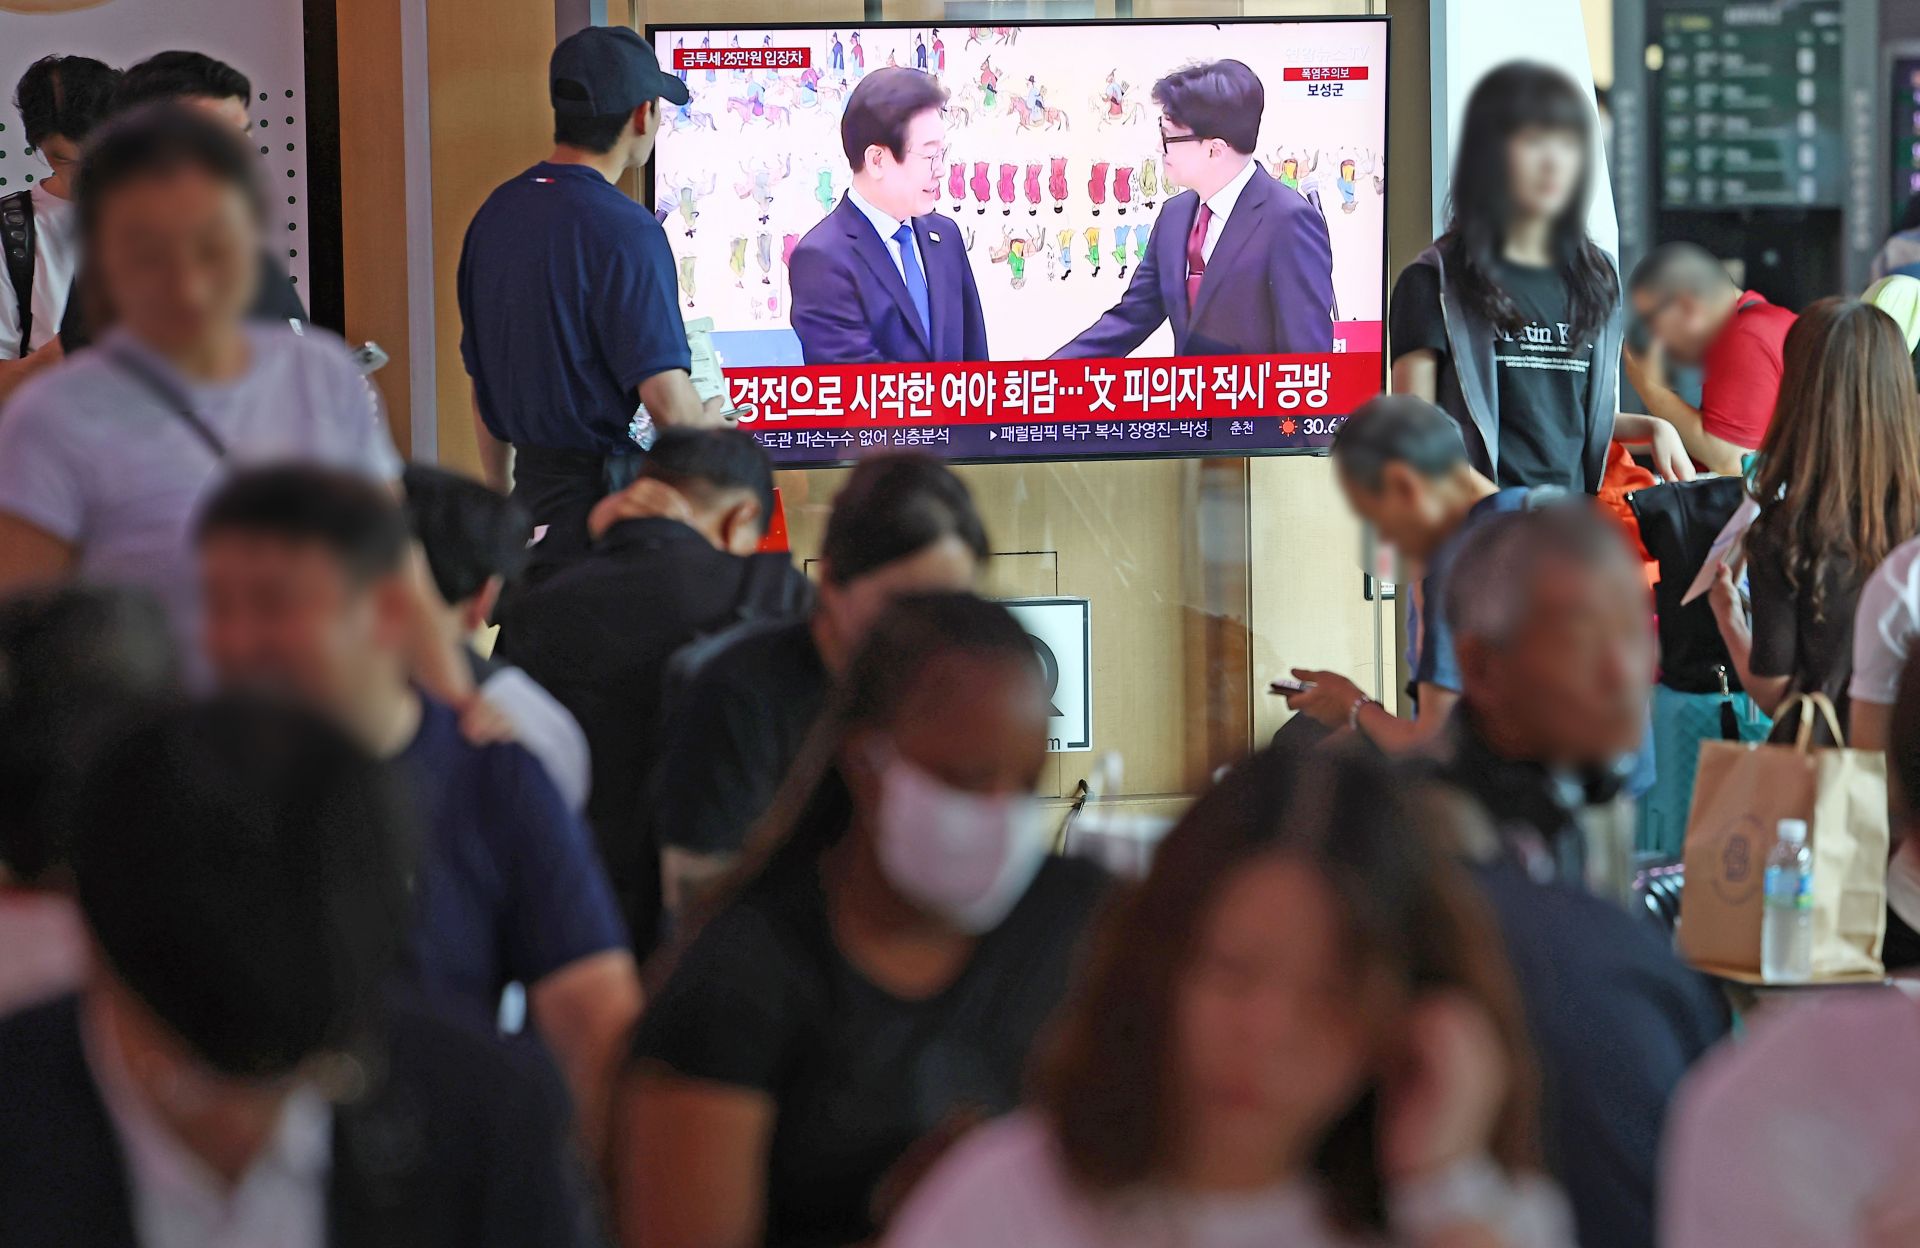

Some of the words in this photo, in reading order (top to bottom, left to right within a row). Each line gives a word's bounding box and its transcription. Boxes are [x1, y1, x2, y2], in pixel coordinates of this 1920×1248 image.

[764, 50, 803, 66] 입장차
[1301, 67, 1350, 79] 폭염주의보
[1307, 83, 1344, 97] 보성군
[725, 375, 844, 423] 경전으로
[849, 371, 935, 419] 시작한
[941, 370, 997, 417] 여야
[1123, 366, 1206, 412] 피의자
[1275, 362, 1332, 409] 공방
[1000, 424, 1059, 443] 패럴림픽
[1062, 423, 1092, 442] 탁구
[1094, 422, 1124, 441] 복식
[1127, 420, 1211, 440] 장영진-박성
[1229, 420, 1254, 436] 춘천
[796, 431, 855, 449] 파손누수
[858, 429, 888, 446] 없어
[892, 427, 951, 446] 심층분석
